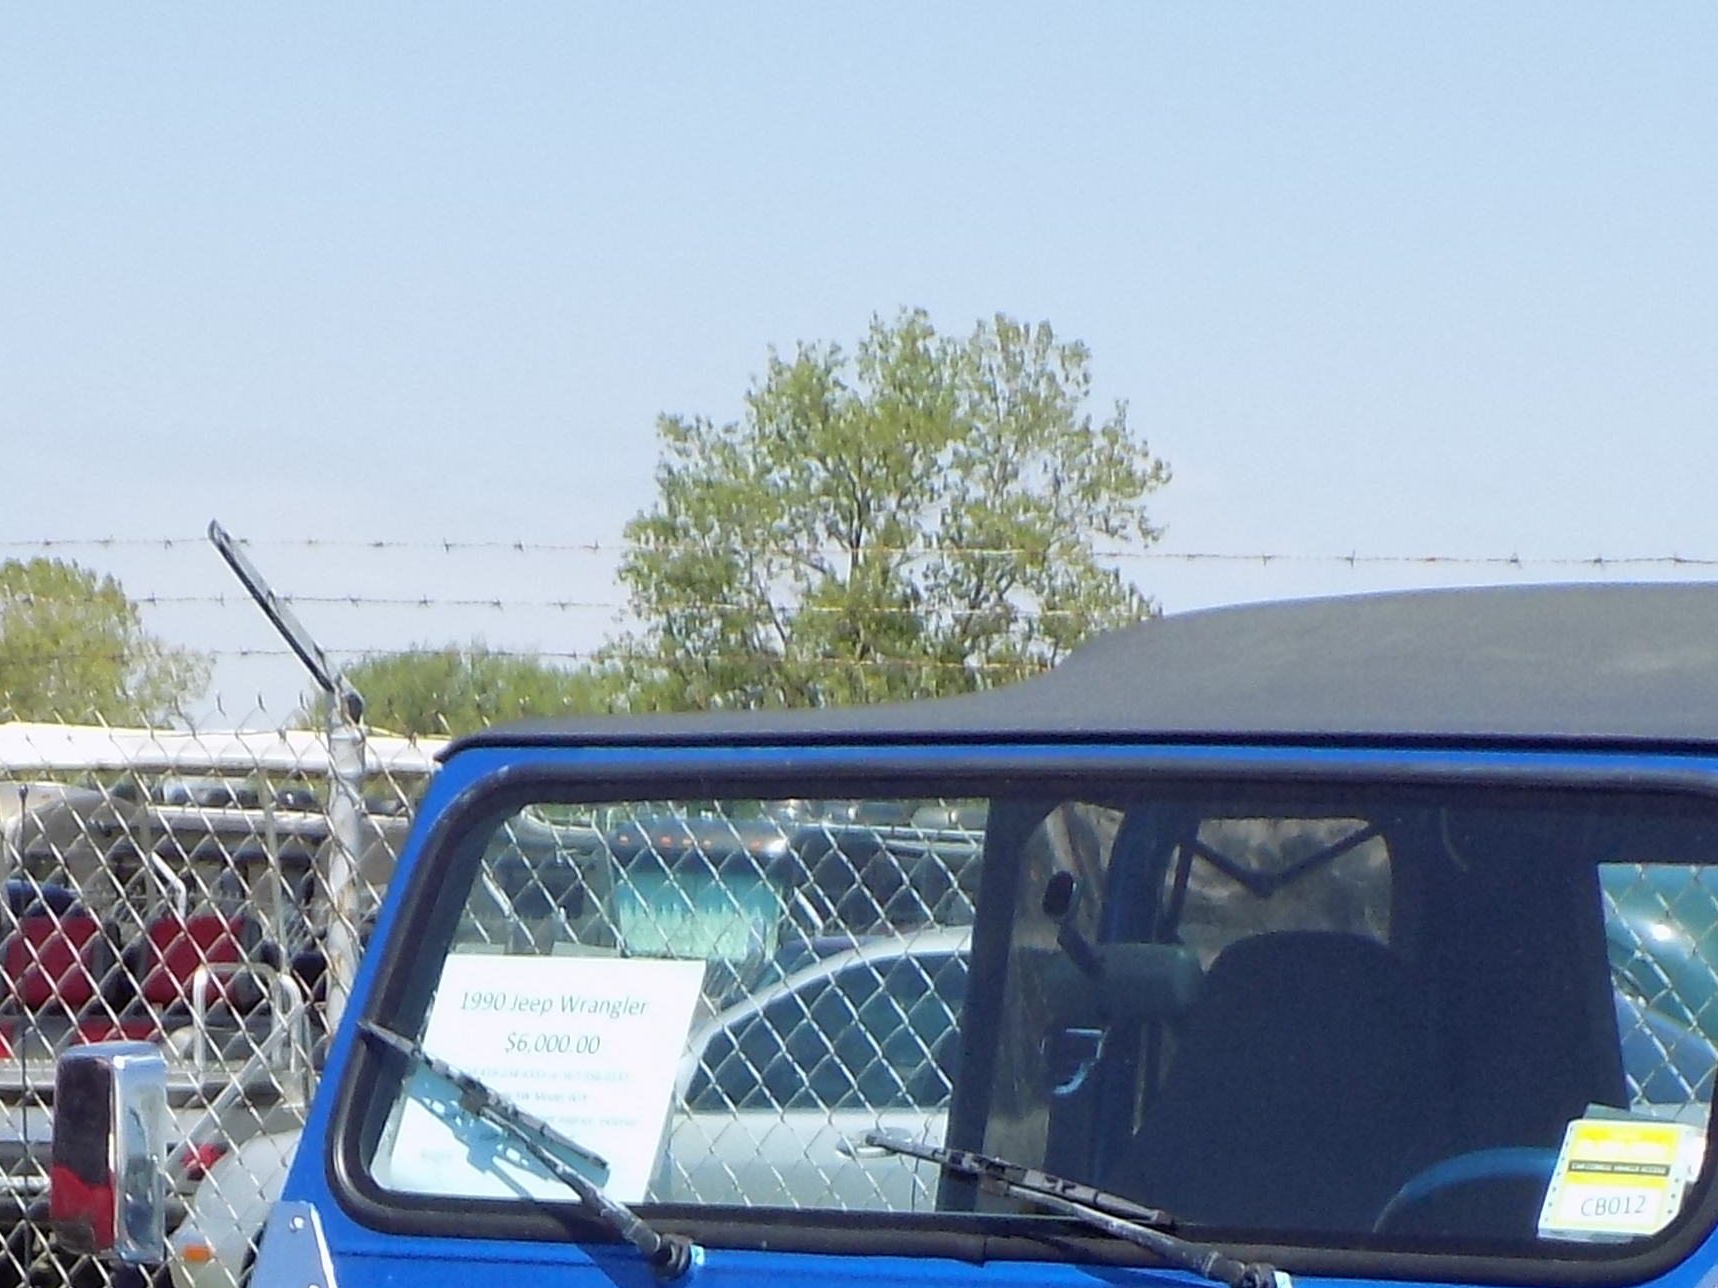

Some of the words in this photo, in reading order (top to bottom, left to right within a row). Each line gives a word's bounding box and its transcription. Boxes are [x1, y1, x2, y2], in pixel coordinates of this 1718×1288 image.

[459, 991, 507, 1013] 1990
[508, 992, 554, 1017] Jeep
[559, 993, 648, 1022] Wrangler
[1580, 1195, 1647, 1217] CB012
